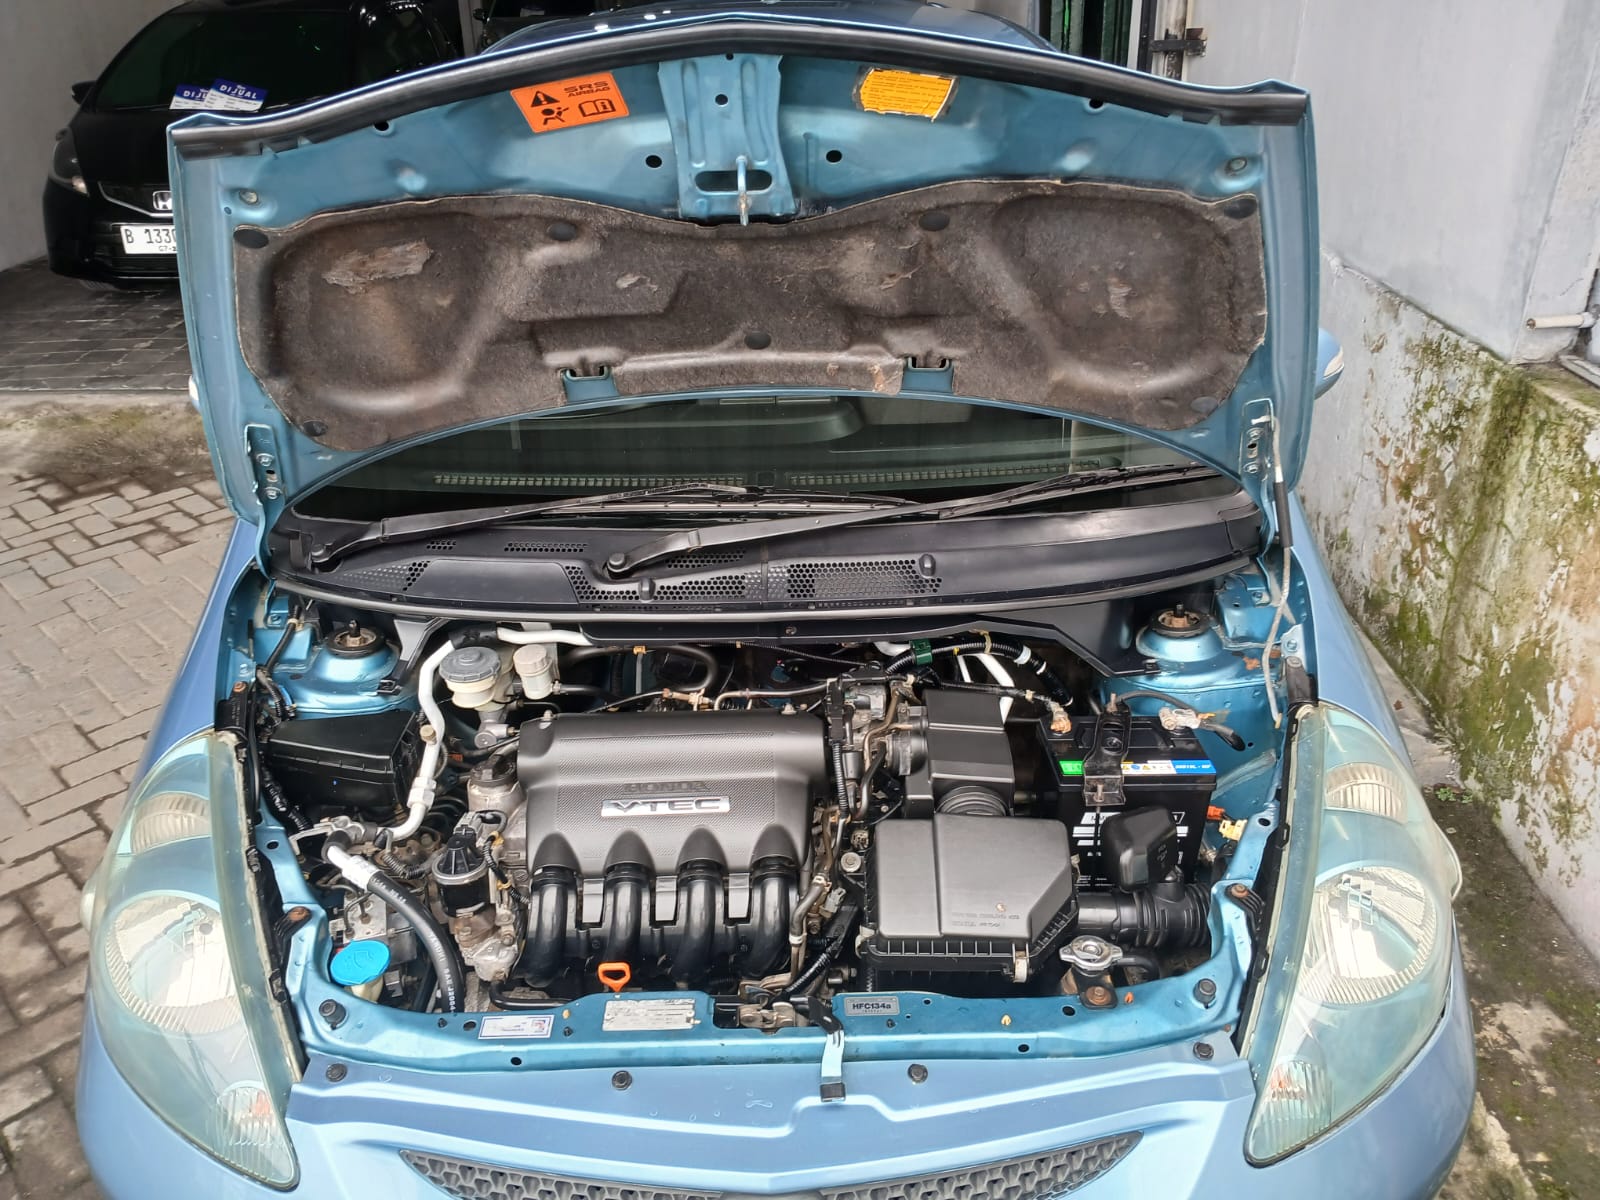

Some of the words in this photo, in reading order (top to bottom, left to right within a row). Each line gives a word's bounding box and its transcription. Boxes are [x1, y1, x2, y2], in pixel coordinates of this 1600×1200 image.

[220, 84, 257, 99] DIJUAL
[564, 81, 608, 93] SRS
[568, 86, 610, 97] AIRBAG
[183, 90, 208, 99] DIJU
[124, 229, 134, 243] B
[610, 797, 722, 813] VTEC
[852, 1002, 892, 1010] HFC134a
